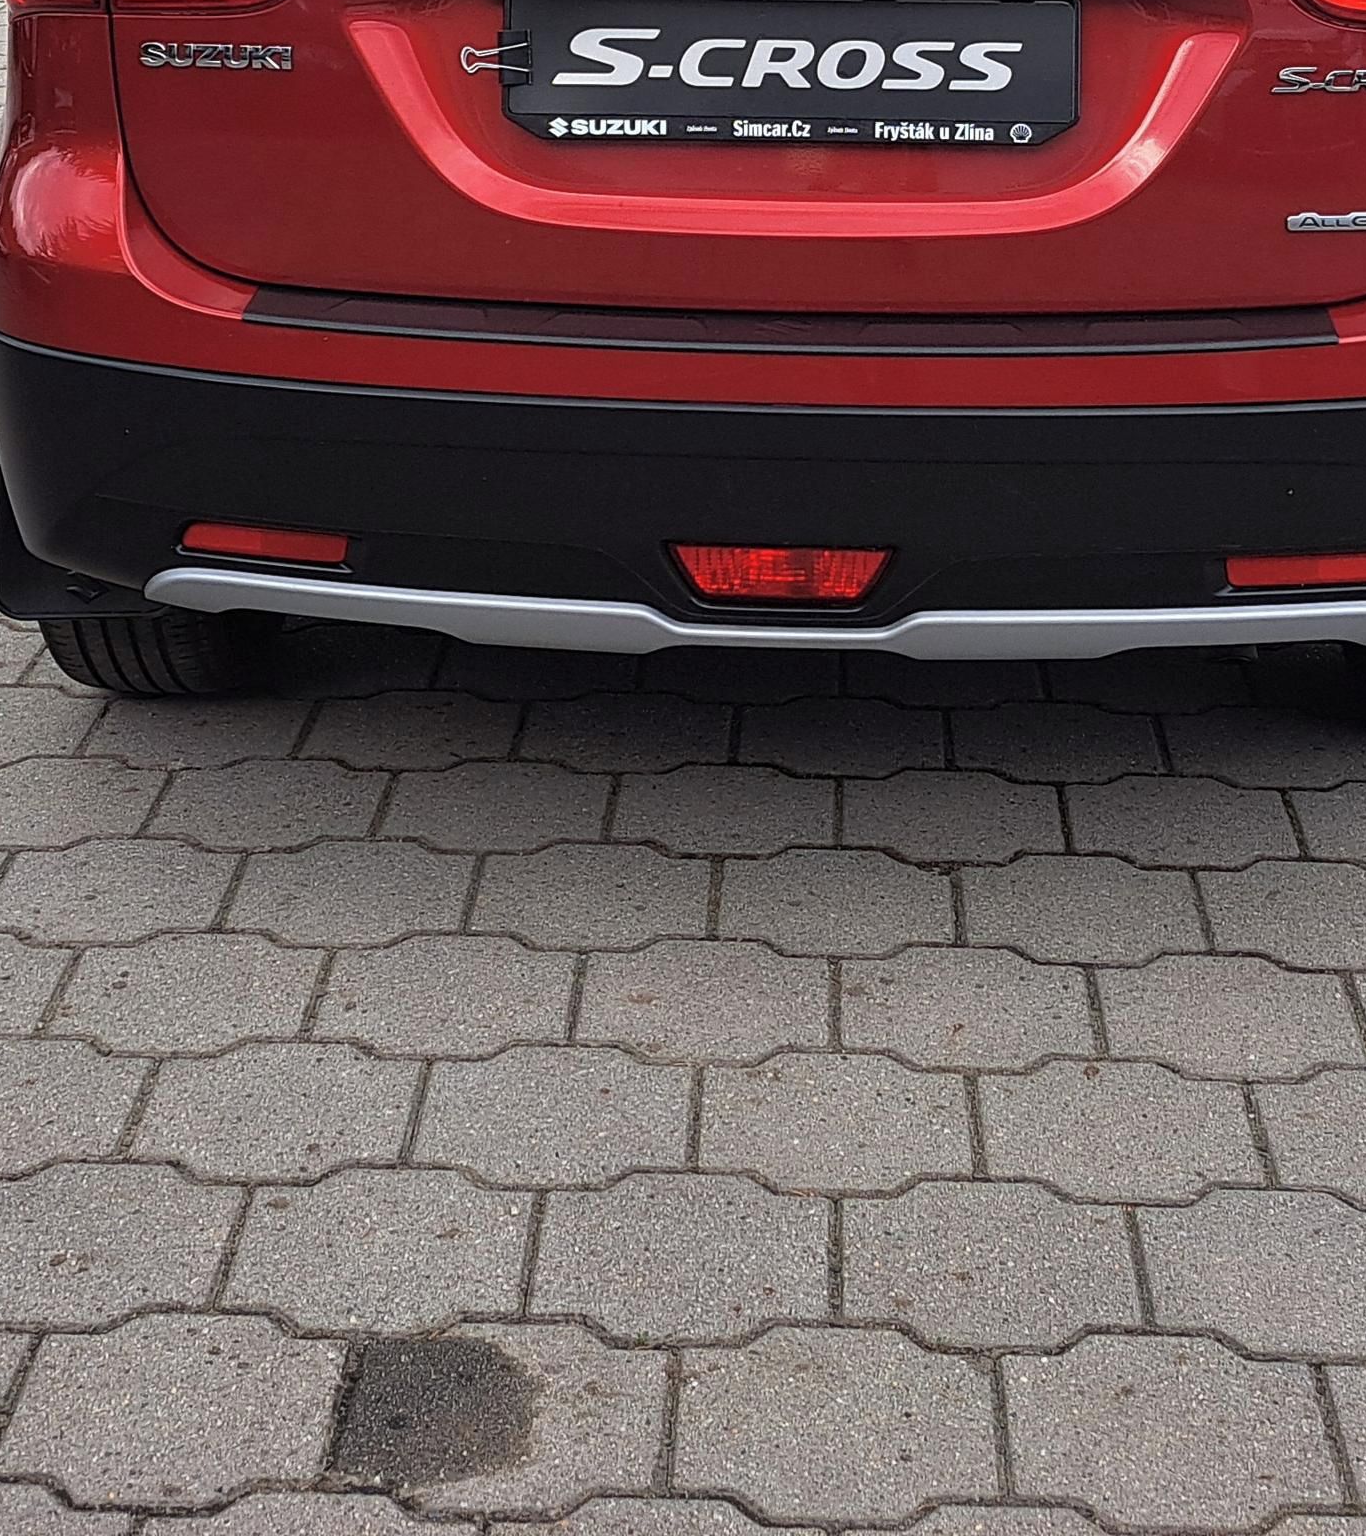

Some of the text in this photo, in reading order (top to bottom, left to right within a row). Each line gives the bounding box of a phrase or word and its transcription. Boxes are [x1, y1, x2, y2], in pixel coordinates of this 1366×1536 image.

[139, 42, 292, 70] SUZUKI
[552, 28, 1023, 91] S-CROSS
[570, 118, 667, 136] SUZUKI
[732, 119, 811, 138] Simcar.Cz
[874, 121, 935, 142] Fryšták
[939, 126, 950, 140] u
